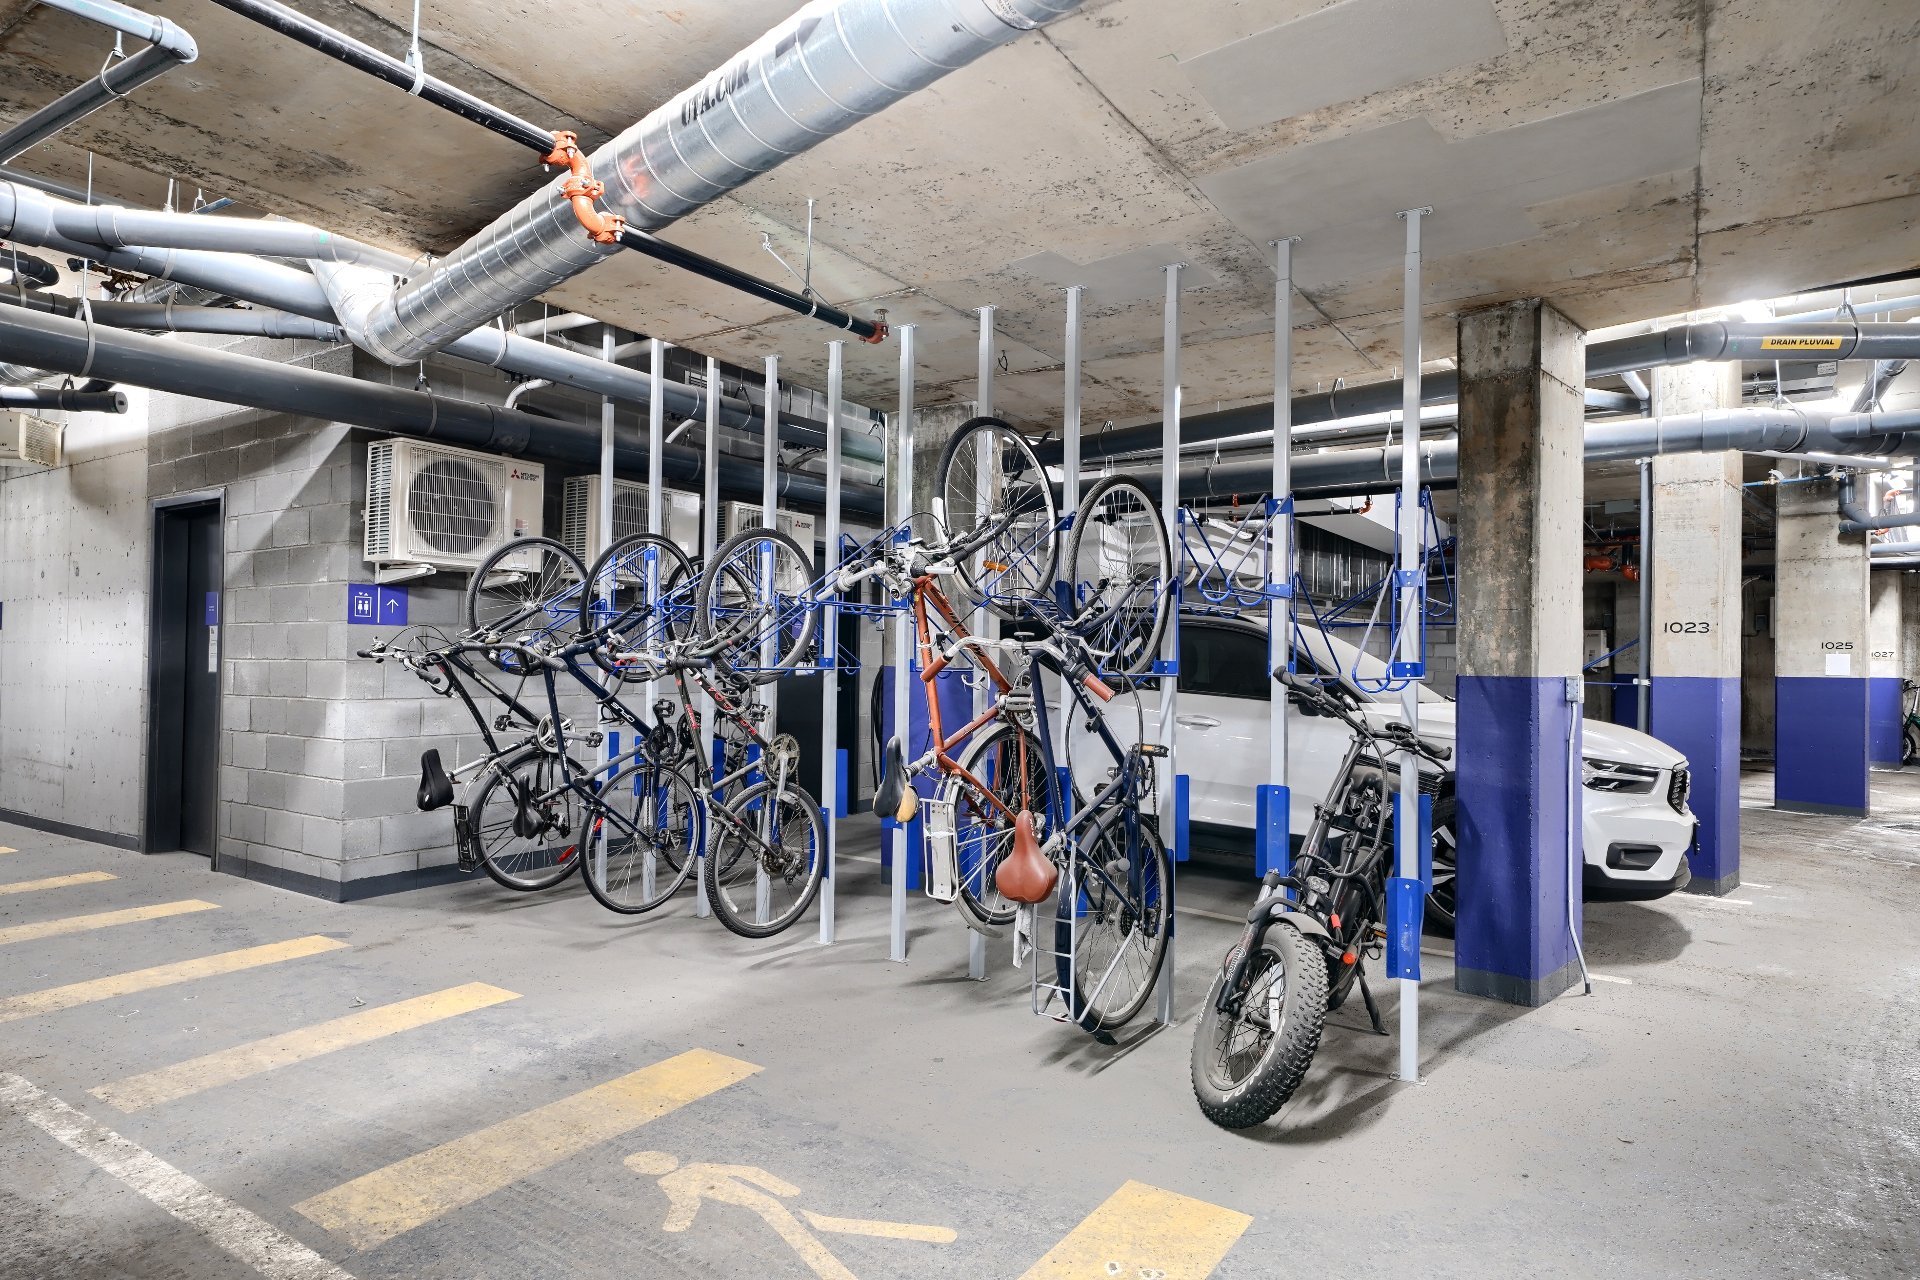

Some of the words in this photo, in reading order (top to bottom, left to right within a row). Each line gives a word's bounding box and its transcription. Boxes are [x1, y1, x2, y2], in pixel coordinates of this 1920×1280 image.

[1799, 338, 1835, 346] PLUVIAL
[1663, 621, 1710, 634] 1023
[1821, 641, 1854, 650] 1025
[610, 701, 636, 723] OPUS
